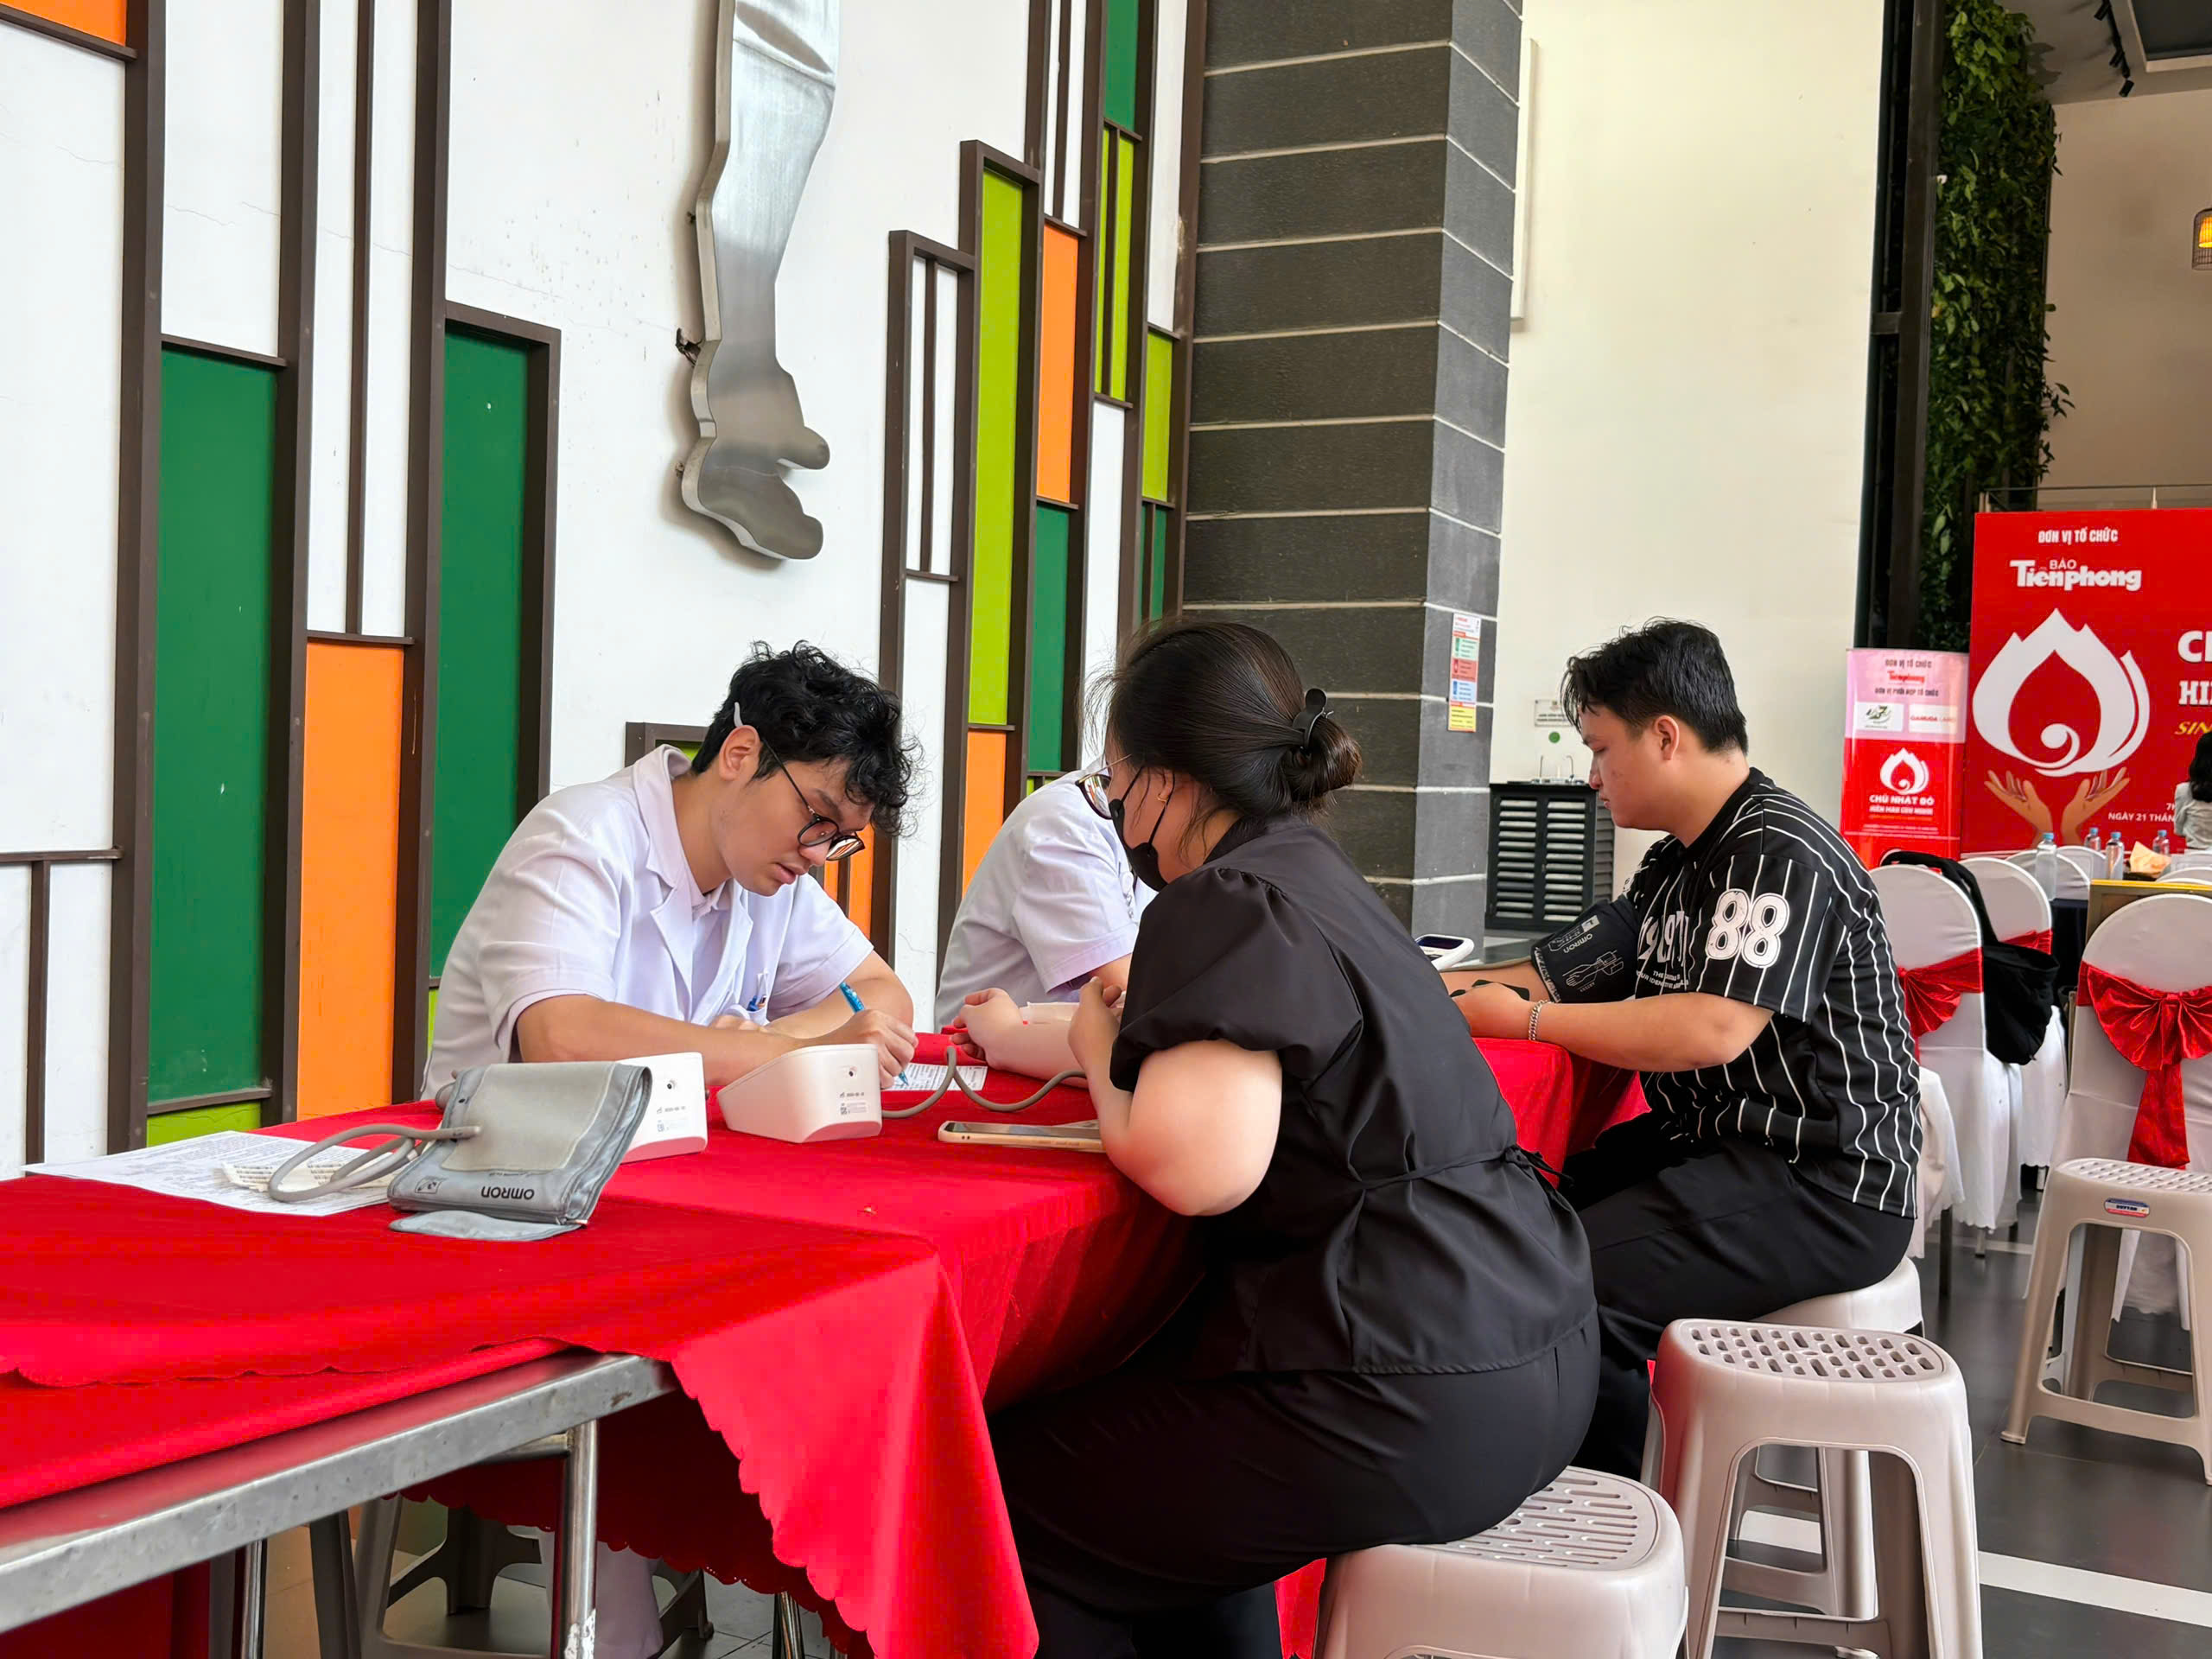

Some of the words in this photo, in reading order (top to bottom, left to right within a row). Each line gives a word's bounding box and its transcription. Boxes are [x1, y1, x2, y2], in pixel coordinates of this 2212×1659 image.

[2089, 526, 2118, 543] CHỨC
[2178, 680, 2212, 706] HI
[2136, 813, 2146, 822] 21
[1706, 888, 1789, 968] 88
[1563, 933, 1593, 953] OMRON
[480, 1185, 535, 1200] OMRON
